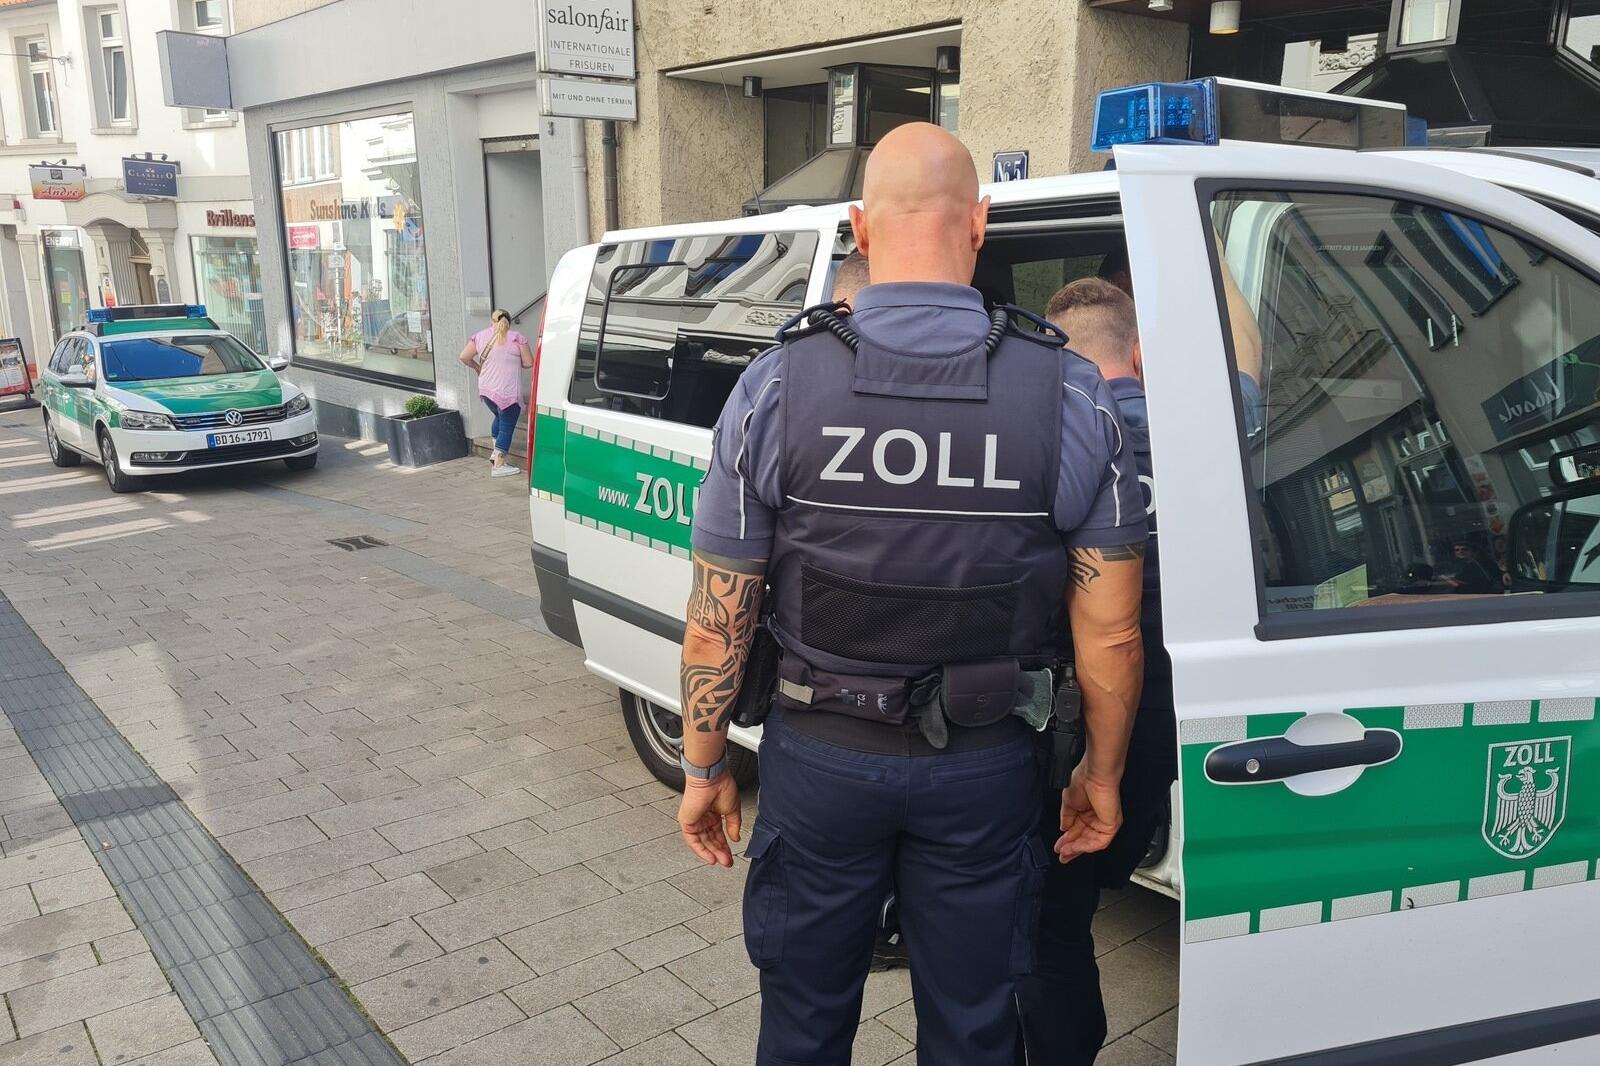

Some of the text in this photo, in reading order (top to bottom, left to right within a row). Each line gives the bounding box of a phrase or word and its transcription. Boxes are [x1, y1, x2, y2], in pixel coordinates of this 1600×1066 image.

[548, 5, 629, 34] salonfair
[550, 40, 631, 57] INTERNATIONALE
[569, 59, 615, 72] FRISUREN
[586, 96, 605, 104] OHNE
[608, 97, 633, 106] TERMIN
[206, 209, 256, 227] Brillens
[310, 197, 386, 220] Sunshine Kids
[820, 426, 1020, 489] ZOLL
[1503, 743, 1555, 767] ZOLL
